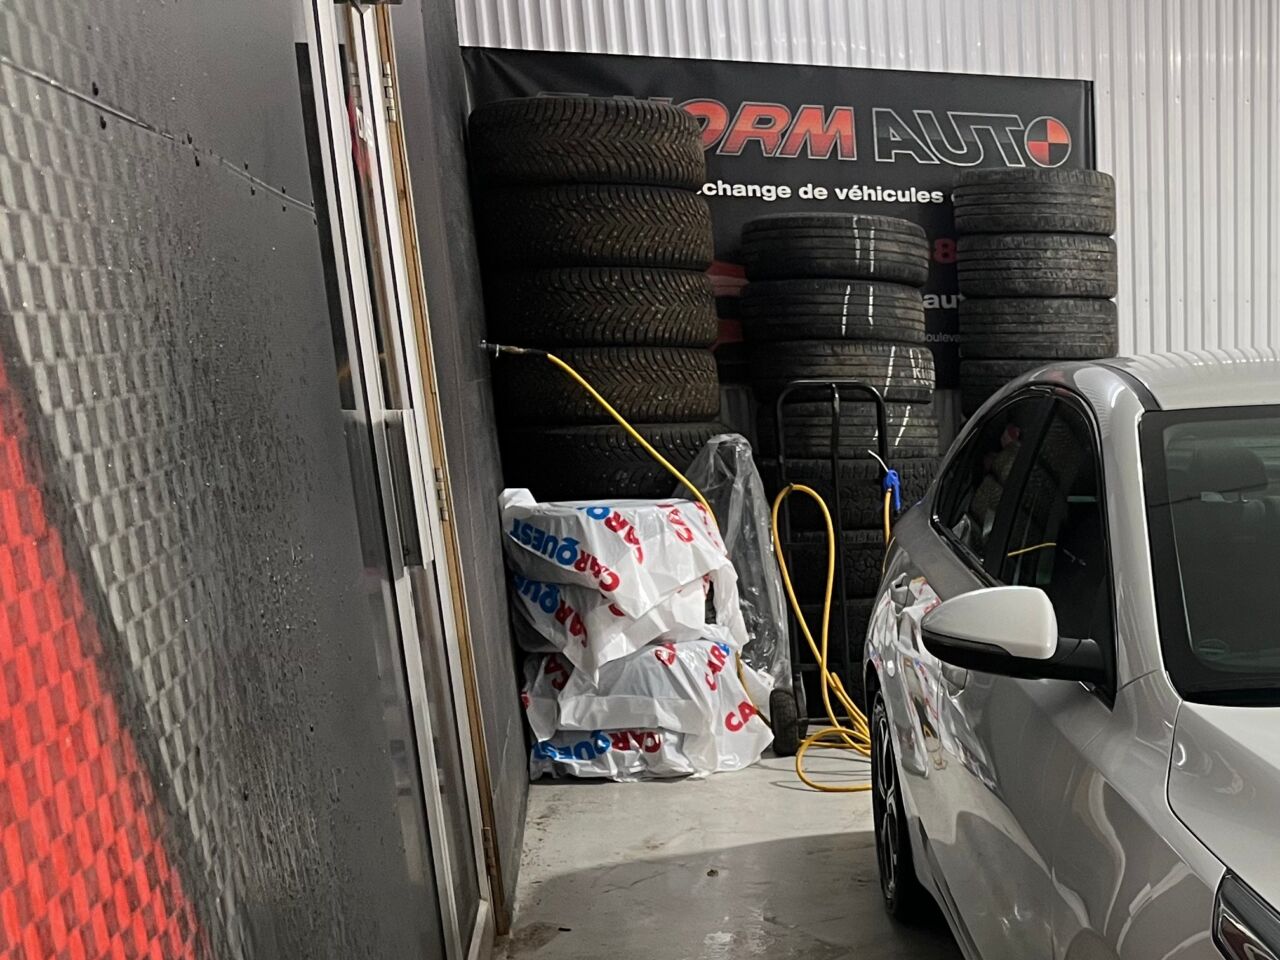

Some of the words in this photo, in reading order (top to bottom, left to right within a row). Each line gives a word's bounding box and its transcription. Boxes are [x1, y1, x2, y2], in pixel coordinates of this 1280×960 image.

[696, 180, 792, 201] change
[799, 183, 828, 200] de
[835, 184, 944, 204] véhicules
[509, 518, 621, 592] CARQUEST
